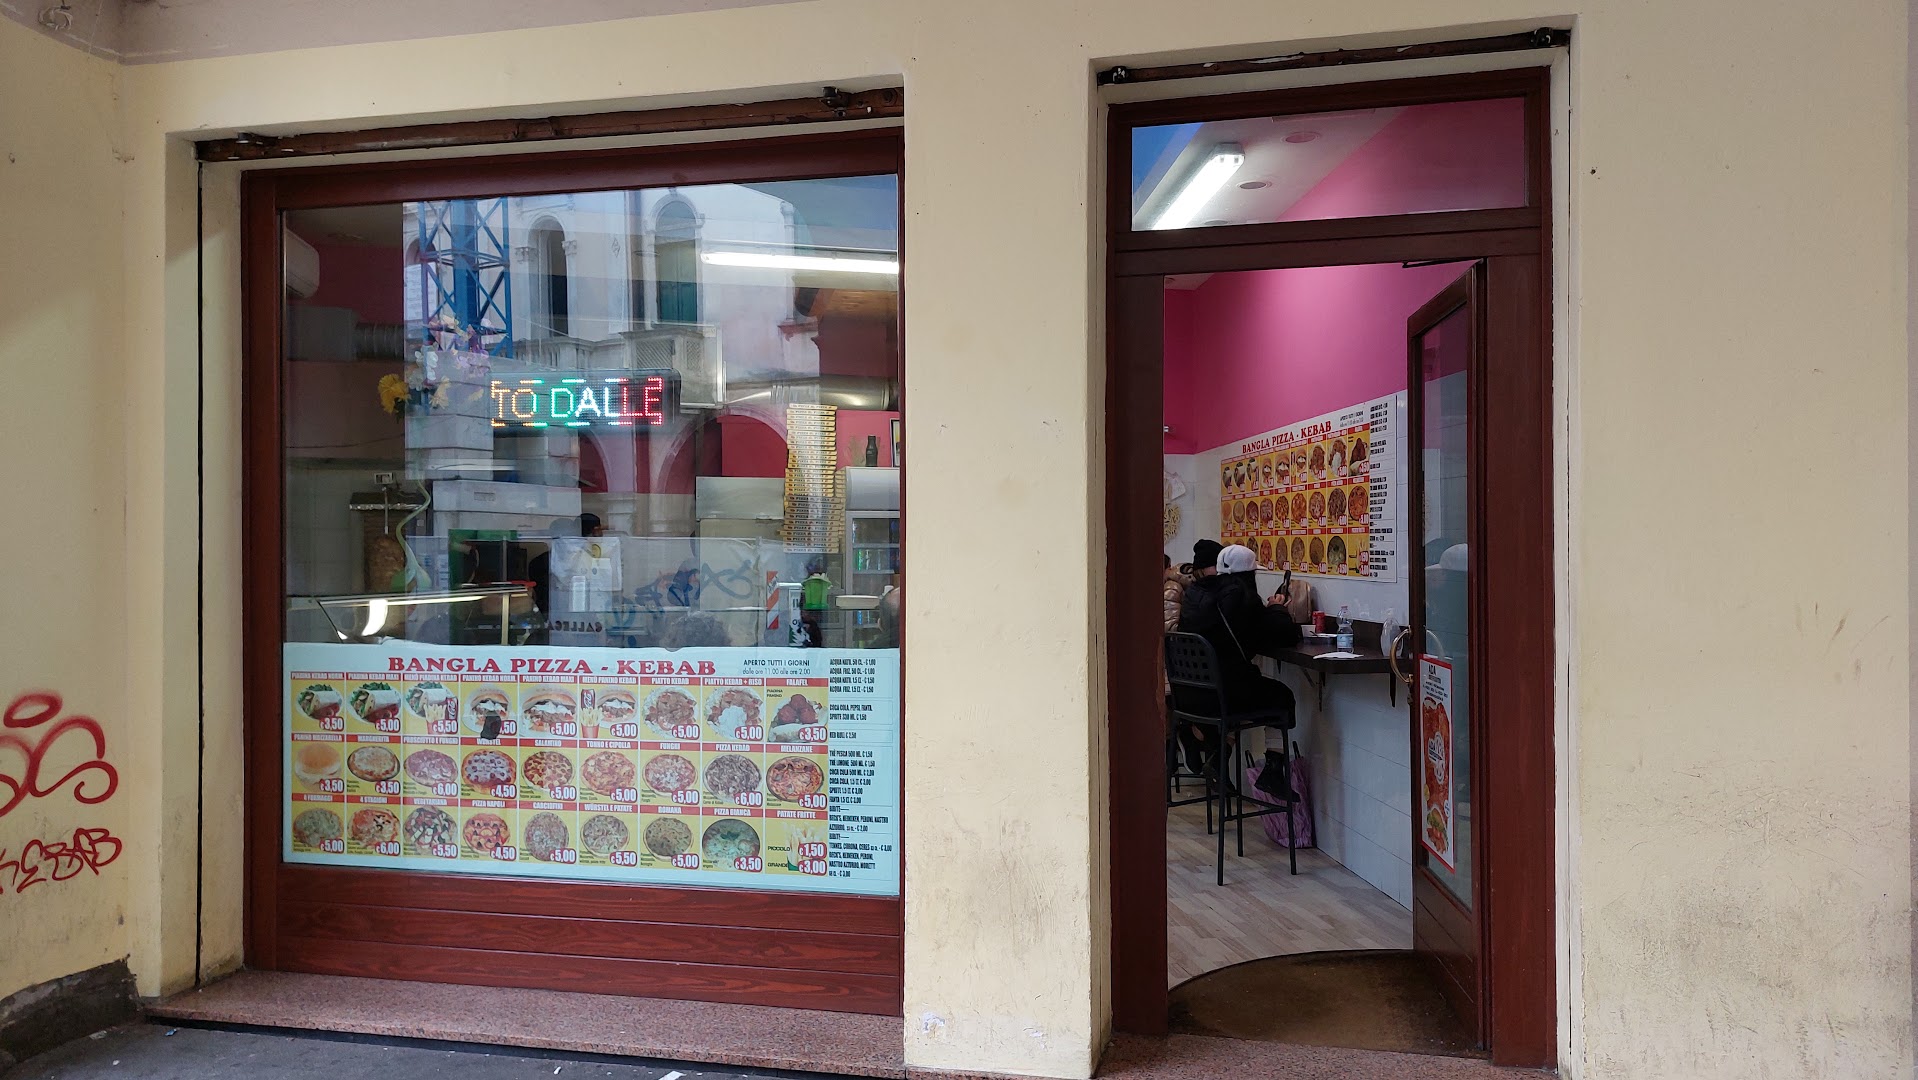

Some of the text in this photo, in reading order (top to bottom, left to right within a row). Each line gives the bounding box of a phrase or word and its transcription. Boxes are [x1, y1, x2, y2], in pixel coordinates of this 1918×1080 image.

[492, 385, 664, 419] TO DALLE
[1242, 437, 1270, 454] BANGLA
[1271, 431, 1295, 446] PIZZA
[1300, 420, 1333, 439] KEBAB
[388, 657, 502, 673] BANGLA
[509, 658, 593, 674] PIZZA
[616, 659, 716, 676] KEBAB
[743, 659, 766, 667] APERTO
[767, 659, 783, 667] TUTTI
[787, 659, 810, 667] GIORNI
[742, 667, 755, 675] dalle
[780, 668, 789, 676] alle
[651, 677, 690, 685] PIATTO KEBAB
[748, 678, 763, 686] RISO
[786, 678, 808, 686] FALAFEL
[534, 739, 562, 747] SALAMINO
[586, 740, 604, 748] TONNO
[609, 741, 631, 749] CIPOLLA
[659, 742, 681, 750] FUNGHI
[715, 743, 750, 752] PIZZA KEBAB
[780, 745, 813, 753] MELANZANE
[486, 800, 505, 808] NAPOLI
[613, 804, 633, 812] PATATE
[657, 806, 682, 814] ROMANA
[713, 807, 751, 816] PIZZA BIANCA
[776, 810, 816, 819] PATATE FRITTE
